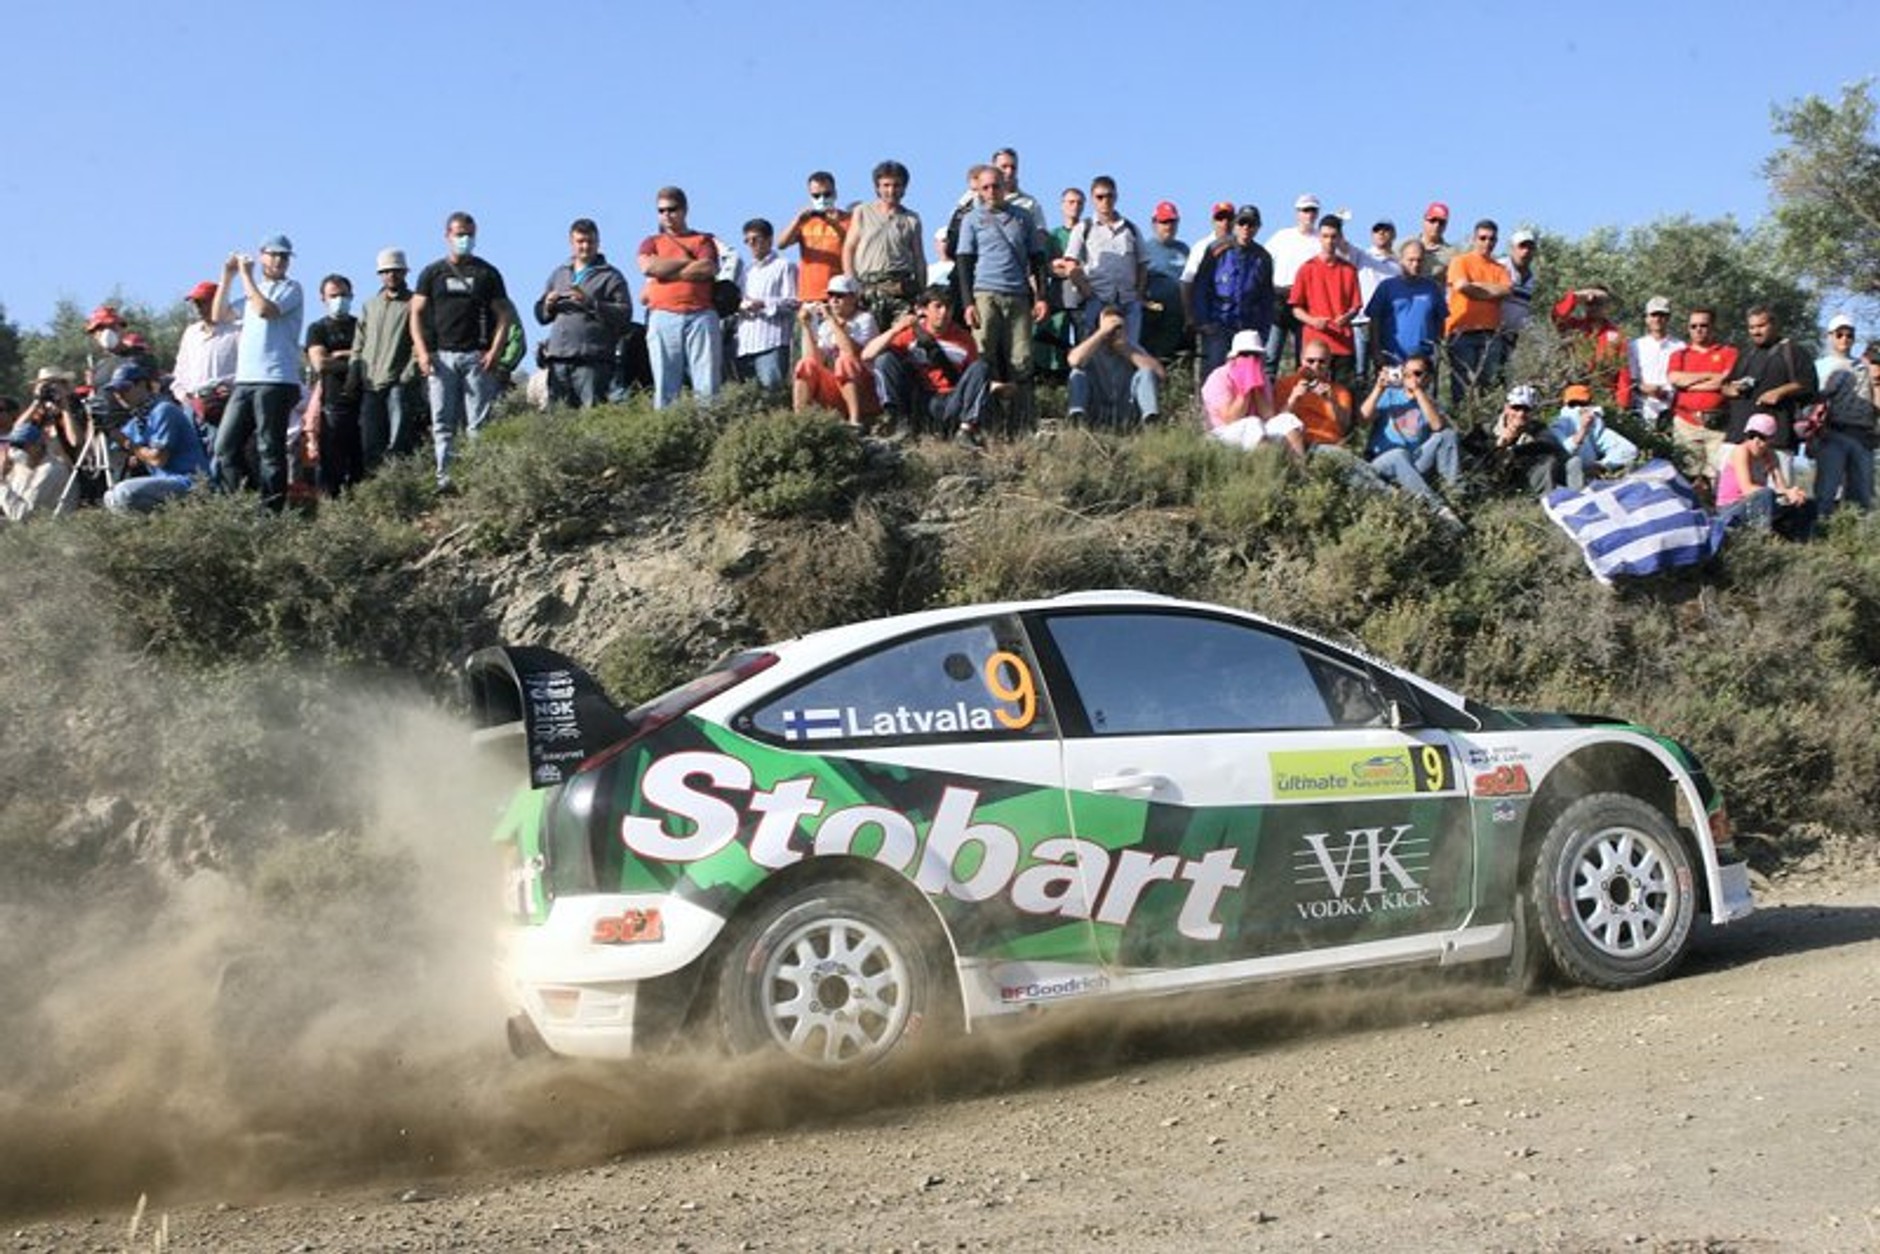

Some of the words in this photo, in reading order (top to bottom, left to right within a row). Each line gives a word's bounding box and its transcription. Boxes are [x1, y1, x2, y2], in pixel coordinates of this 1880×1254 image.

[534, 700, 575, 716] NGK
[984, 650, 1036, 730] 9
[846, 702, 993, 736] Latvala
[1278, 774, 1348, 791] ultimate
[1422, 745, 1444, 792] 9
[620, 750, 1246, 941] Stobart
[1302, 823, 1423, 899] VK
[1297, 897, 1373, 919] VODKA
[1381, 888, 1431, 910] KICK
